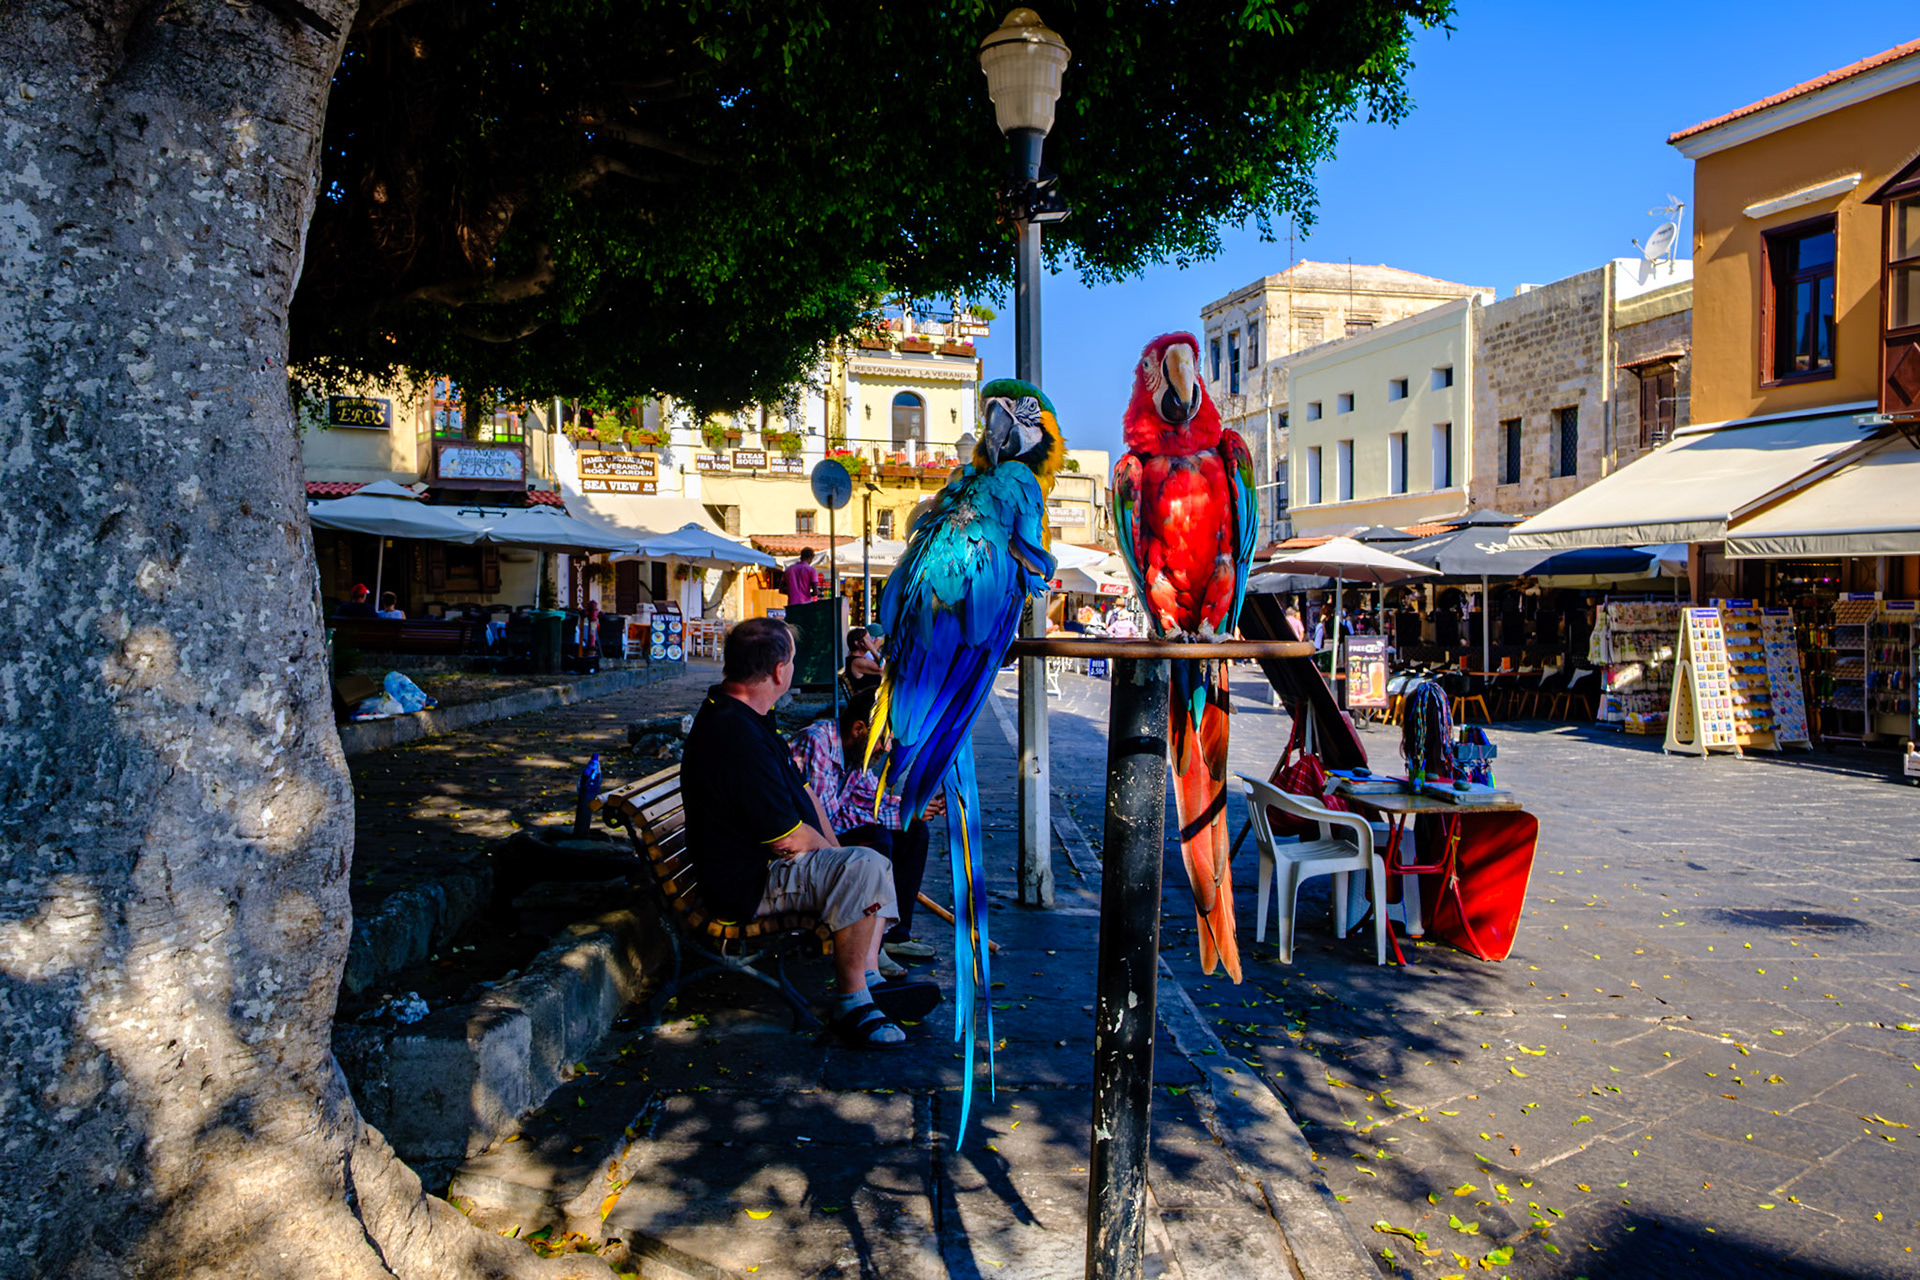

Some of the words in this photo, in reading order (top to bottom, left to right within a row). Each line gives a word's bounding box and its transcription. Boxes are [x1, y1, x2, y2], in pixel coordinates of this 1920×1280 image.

[855, 366, 912, 374] RESTAURANT
[337, 408, 386, 425] EROS
[583, 456, 606, 464] FAMILY
[611, 456, 654, 468] RESTAURANT
[458, 463, 504, 477] EROS
[583, 480, 608, 490] SEA
[608, 481, 640, 492] VIEW
